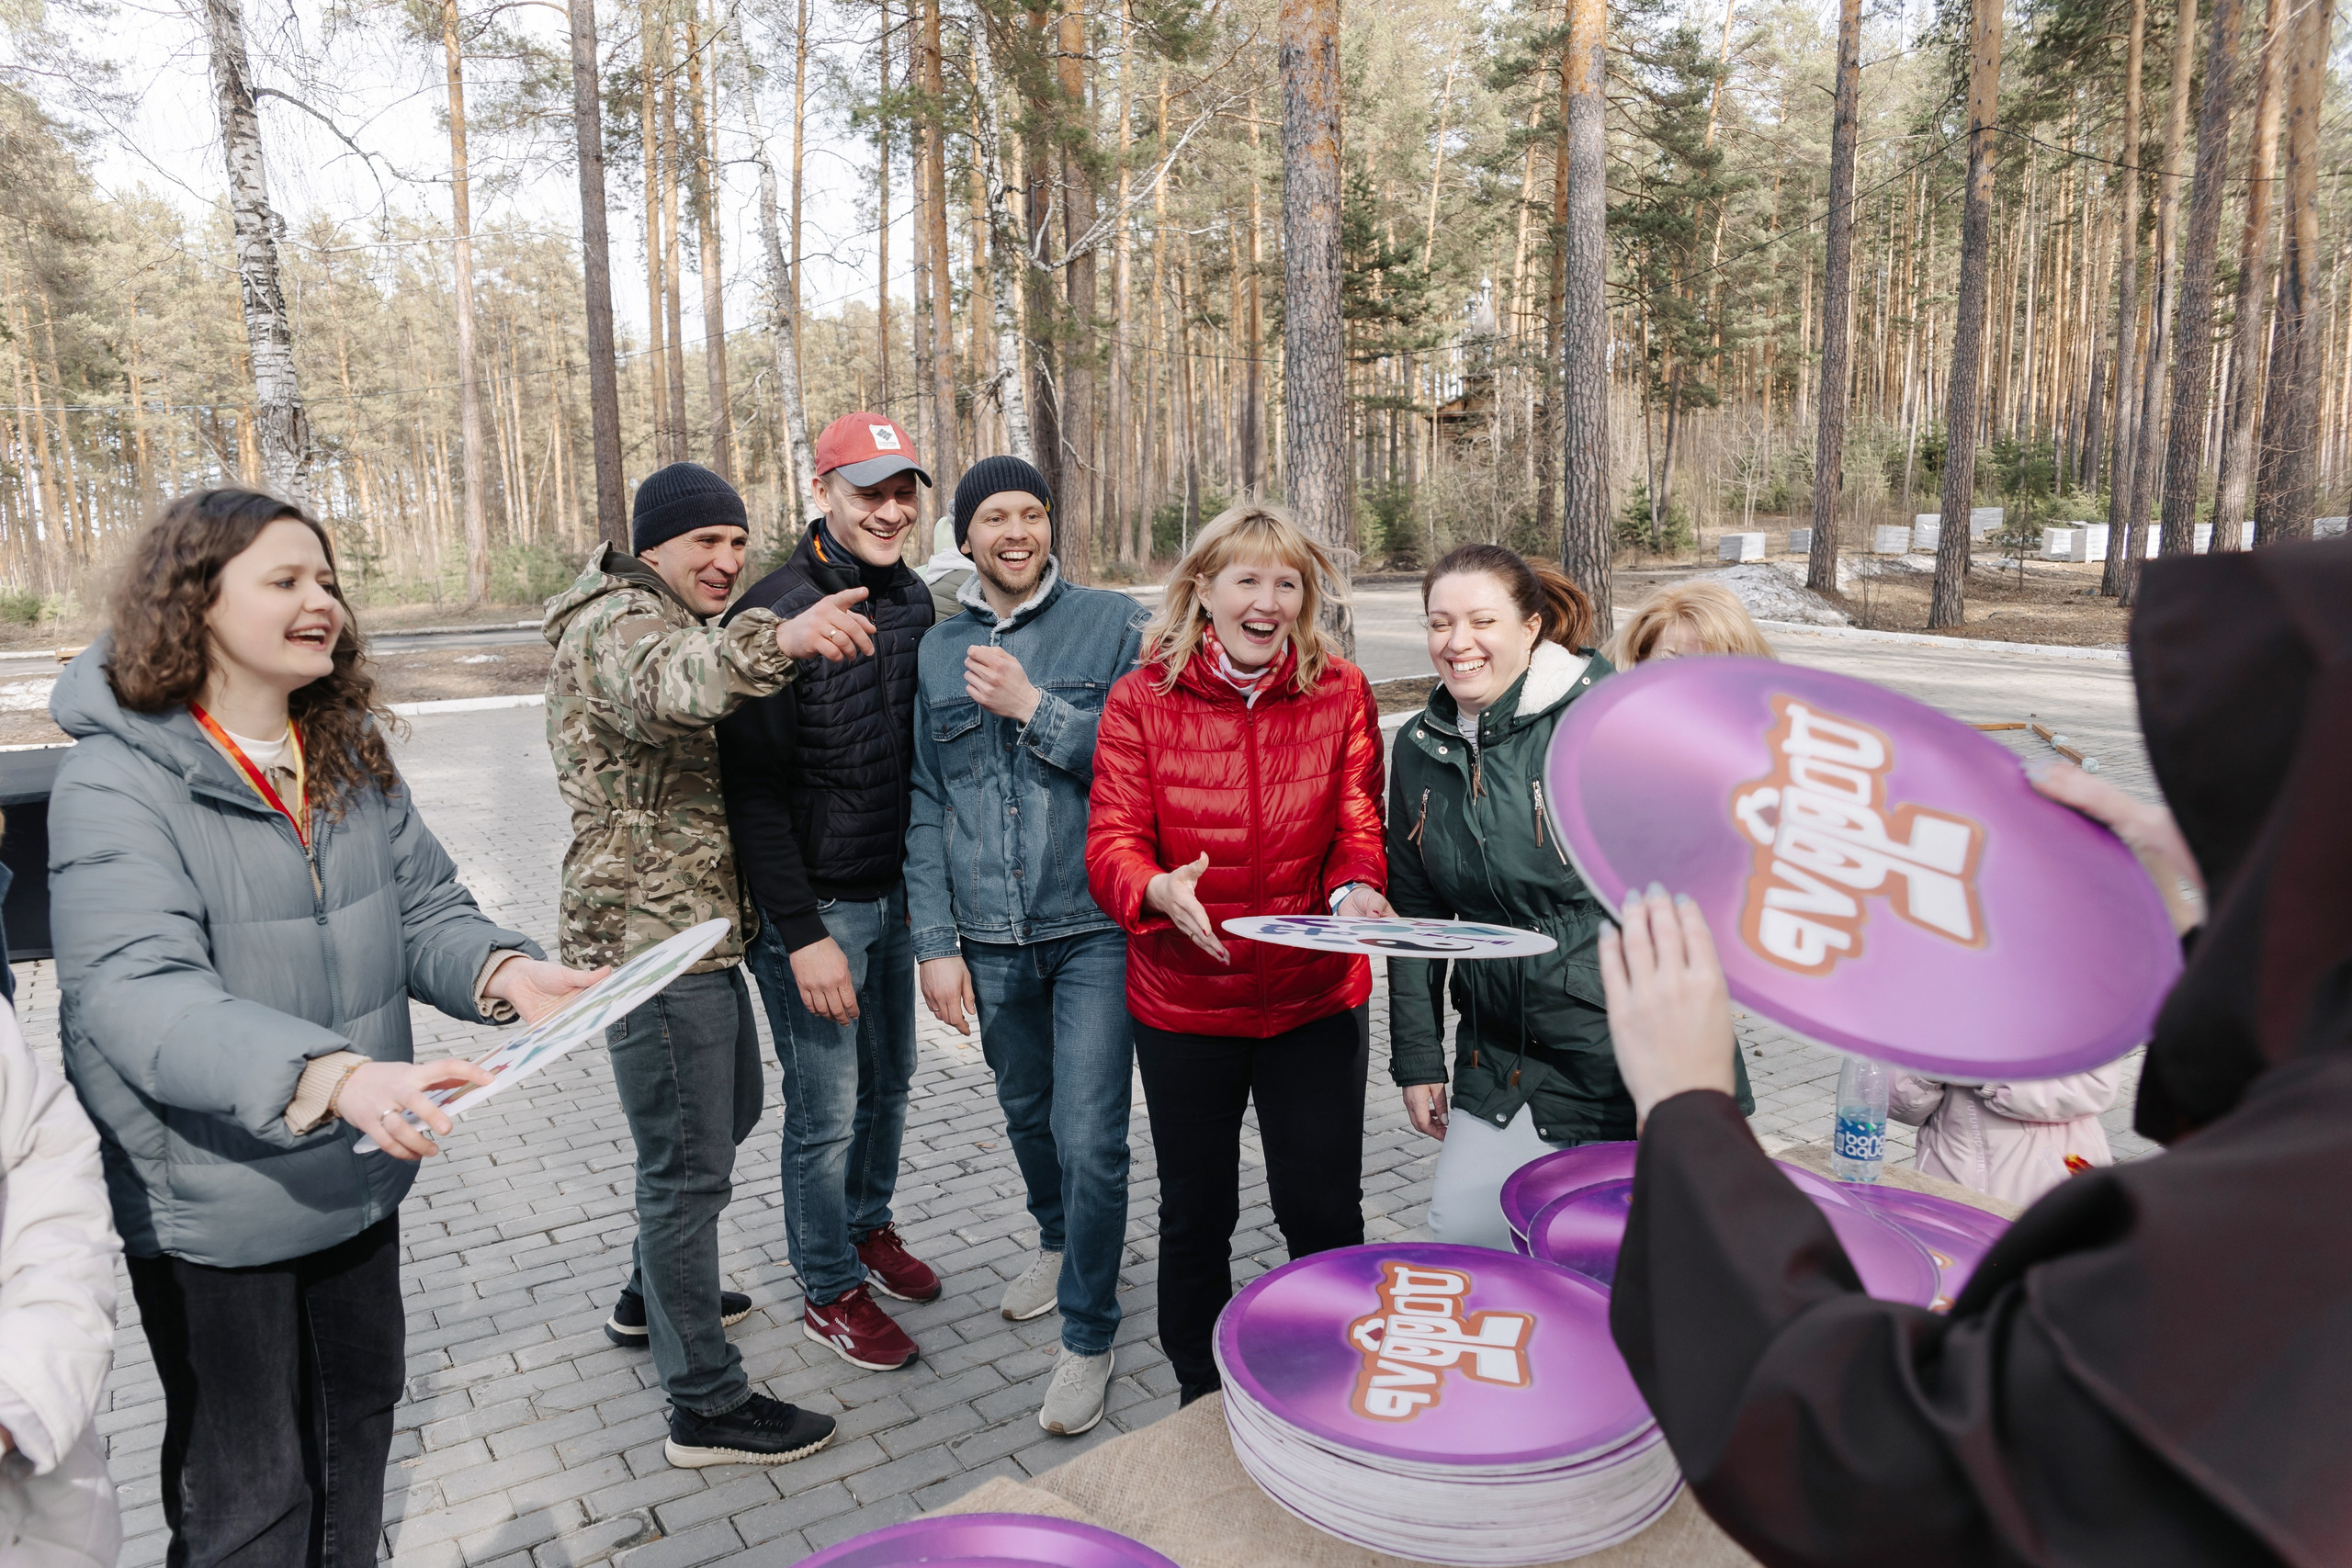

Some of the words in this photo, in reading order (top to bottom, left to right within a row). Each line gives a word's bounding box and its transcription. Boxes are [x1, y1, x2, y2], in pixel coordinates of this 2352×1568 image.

[1966, 1100, 1983, 1147] FUTURINO
[1976, 1152, 1985, 1174] GIRL
[834, 1317, 850, 1333] Reebok
